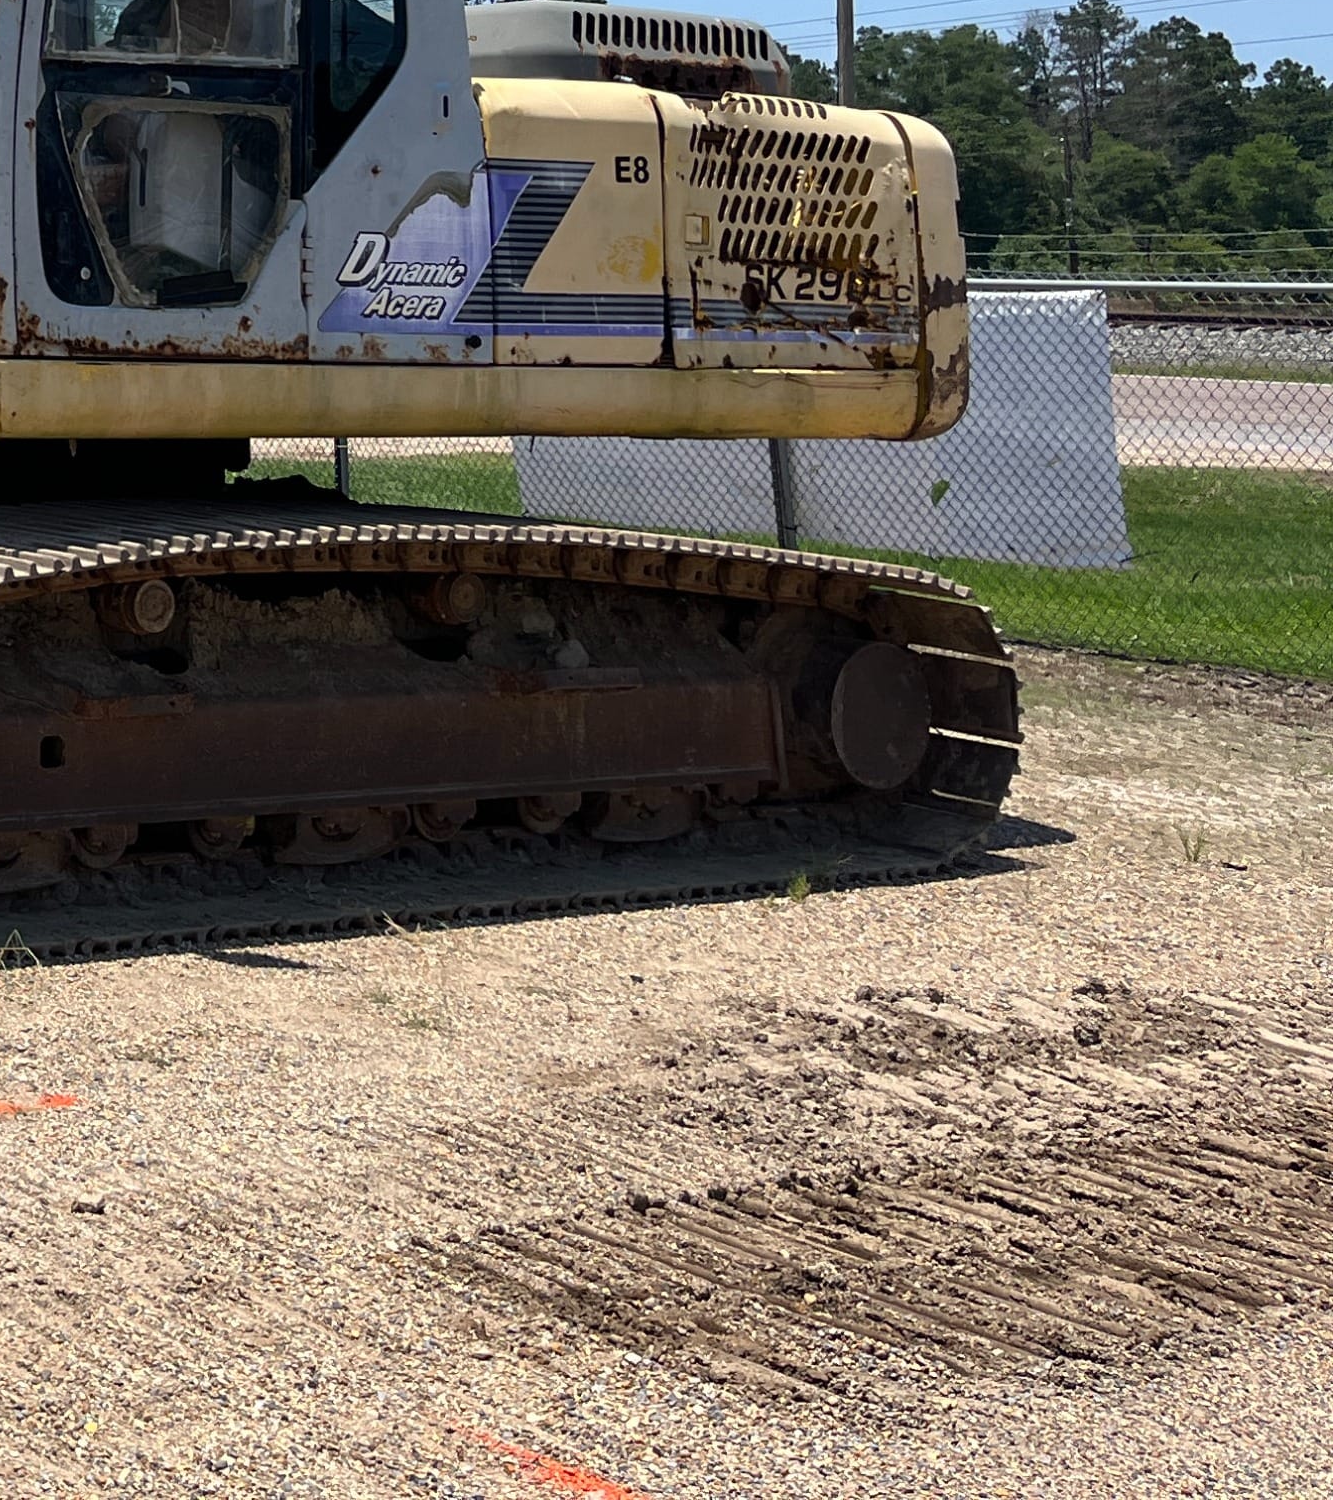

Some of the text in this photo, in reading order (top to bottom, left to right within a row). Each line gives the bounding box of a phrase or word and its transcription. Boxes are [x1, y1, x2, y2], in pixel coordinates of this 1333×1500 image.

[615, 155, 650, 184] E8
[336, 231, 468, 293] Dynamic
[362, 286, 447, 320] Acera
